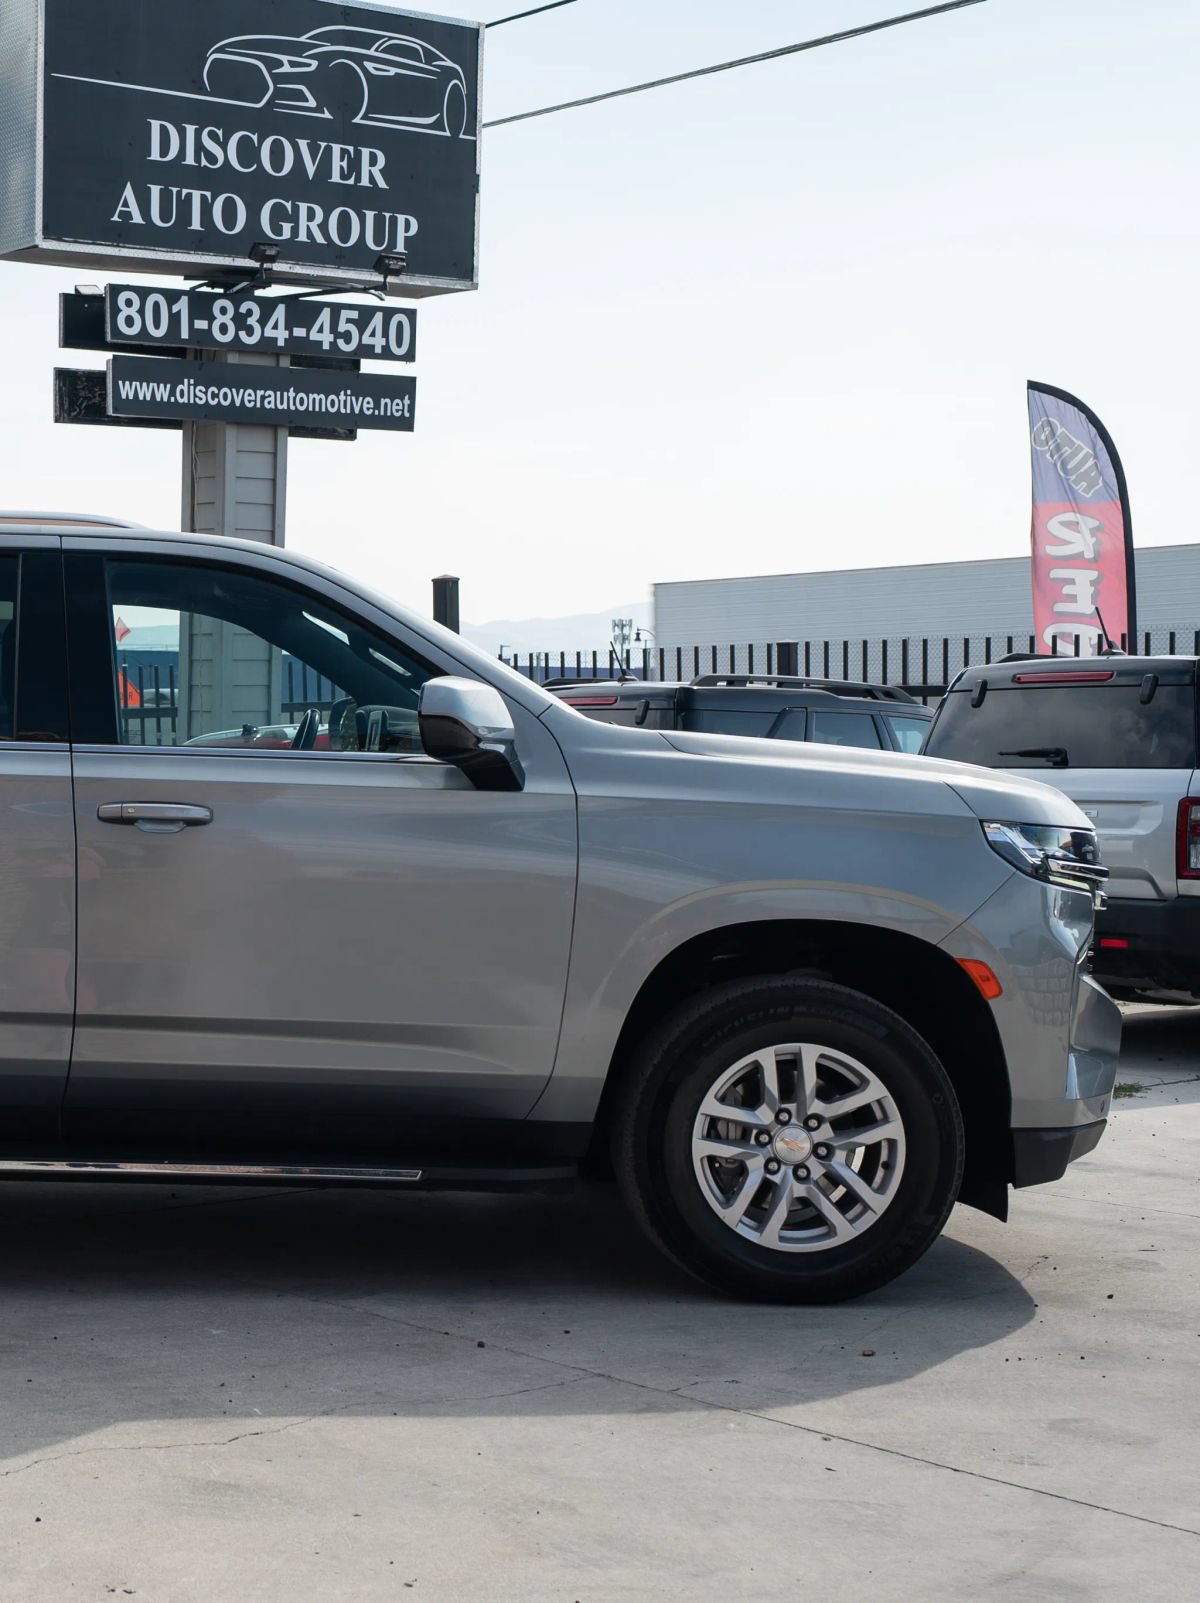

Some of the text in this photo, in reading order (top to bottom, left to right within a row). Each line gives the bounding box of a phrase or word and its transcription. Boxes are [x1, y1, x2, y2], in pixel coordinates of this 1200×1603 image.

[146, 118, 389, 189] DISCOVER
[109, 180, 419, 254] AUTO GROUP
[116, 290, 411, 356] 801-834-4540
[118, 378, 411, 418] www.discoverautomotive.net
